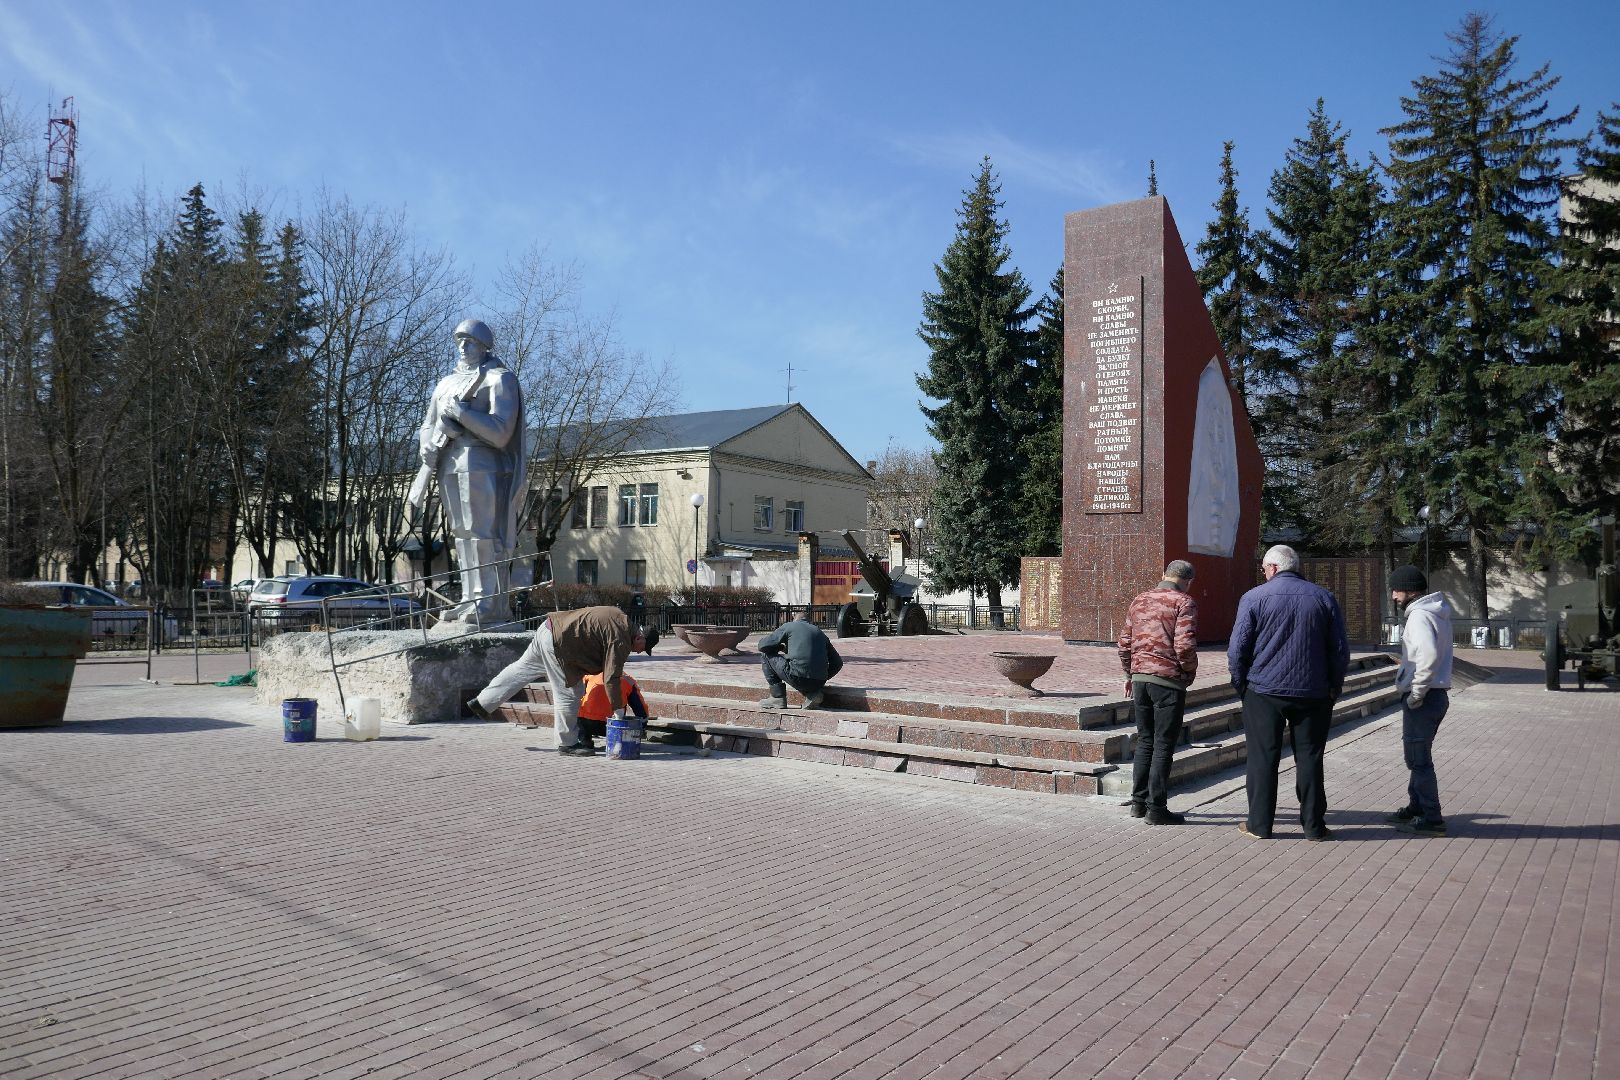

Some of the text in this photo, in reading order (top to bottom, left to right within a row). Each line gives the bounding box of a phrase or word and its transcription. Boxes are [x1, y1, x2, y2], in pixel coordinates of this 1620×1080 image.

[1100, 321, 1126, 330] СЛАВЫ
[1100, 328, 1139, 338] ЗАМЕНИТЬ
[1091, 337, 1136, 348] ПОГИБШЕГО
[1108, 354, 1130, 362] БУДЕТ
[1098, 361, 1128, 370] ВЕЧНОЙ
[1103, 370, 1130, 378] ГЕРОЯХ
[1098, 395, 1128, 403] НАВЕКИ
[1101, 403, 1136, 411] МЕРКНЕТ
[1097, 427, 1128, 436] РАТНЫЙ
[1094, 436, 1131, 444] ПОТОМКИ
